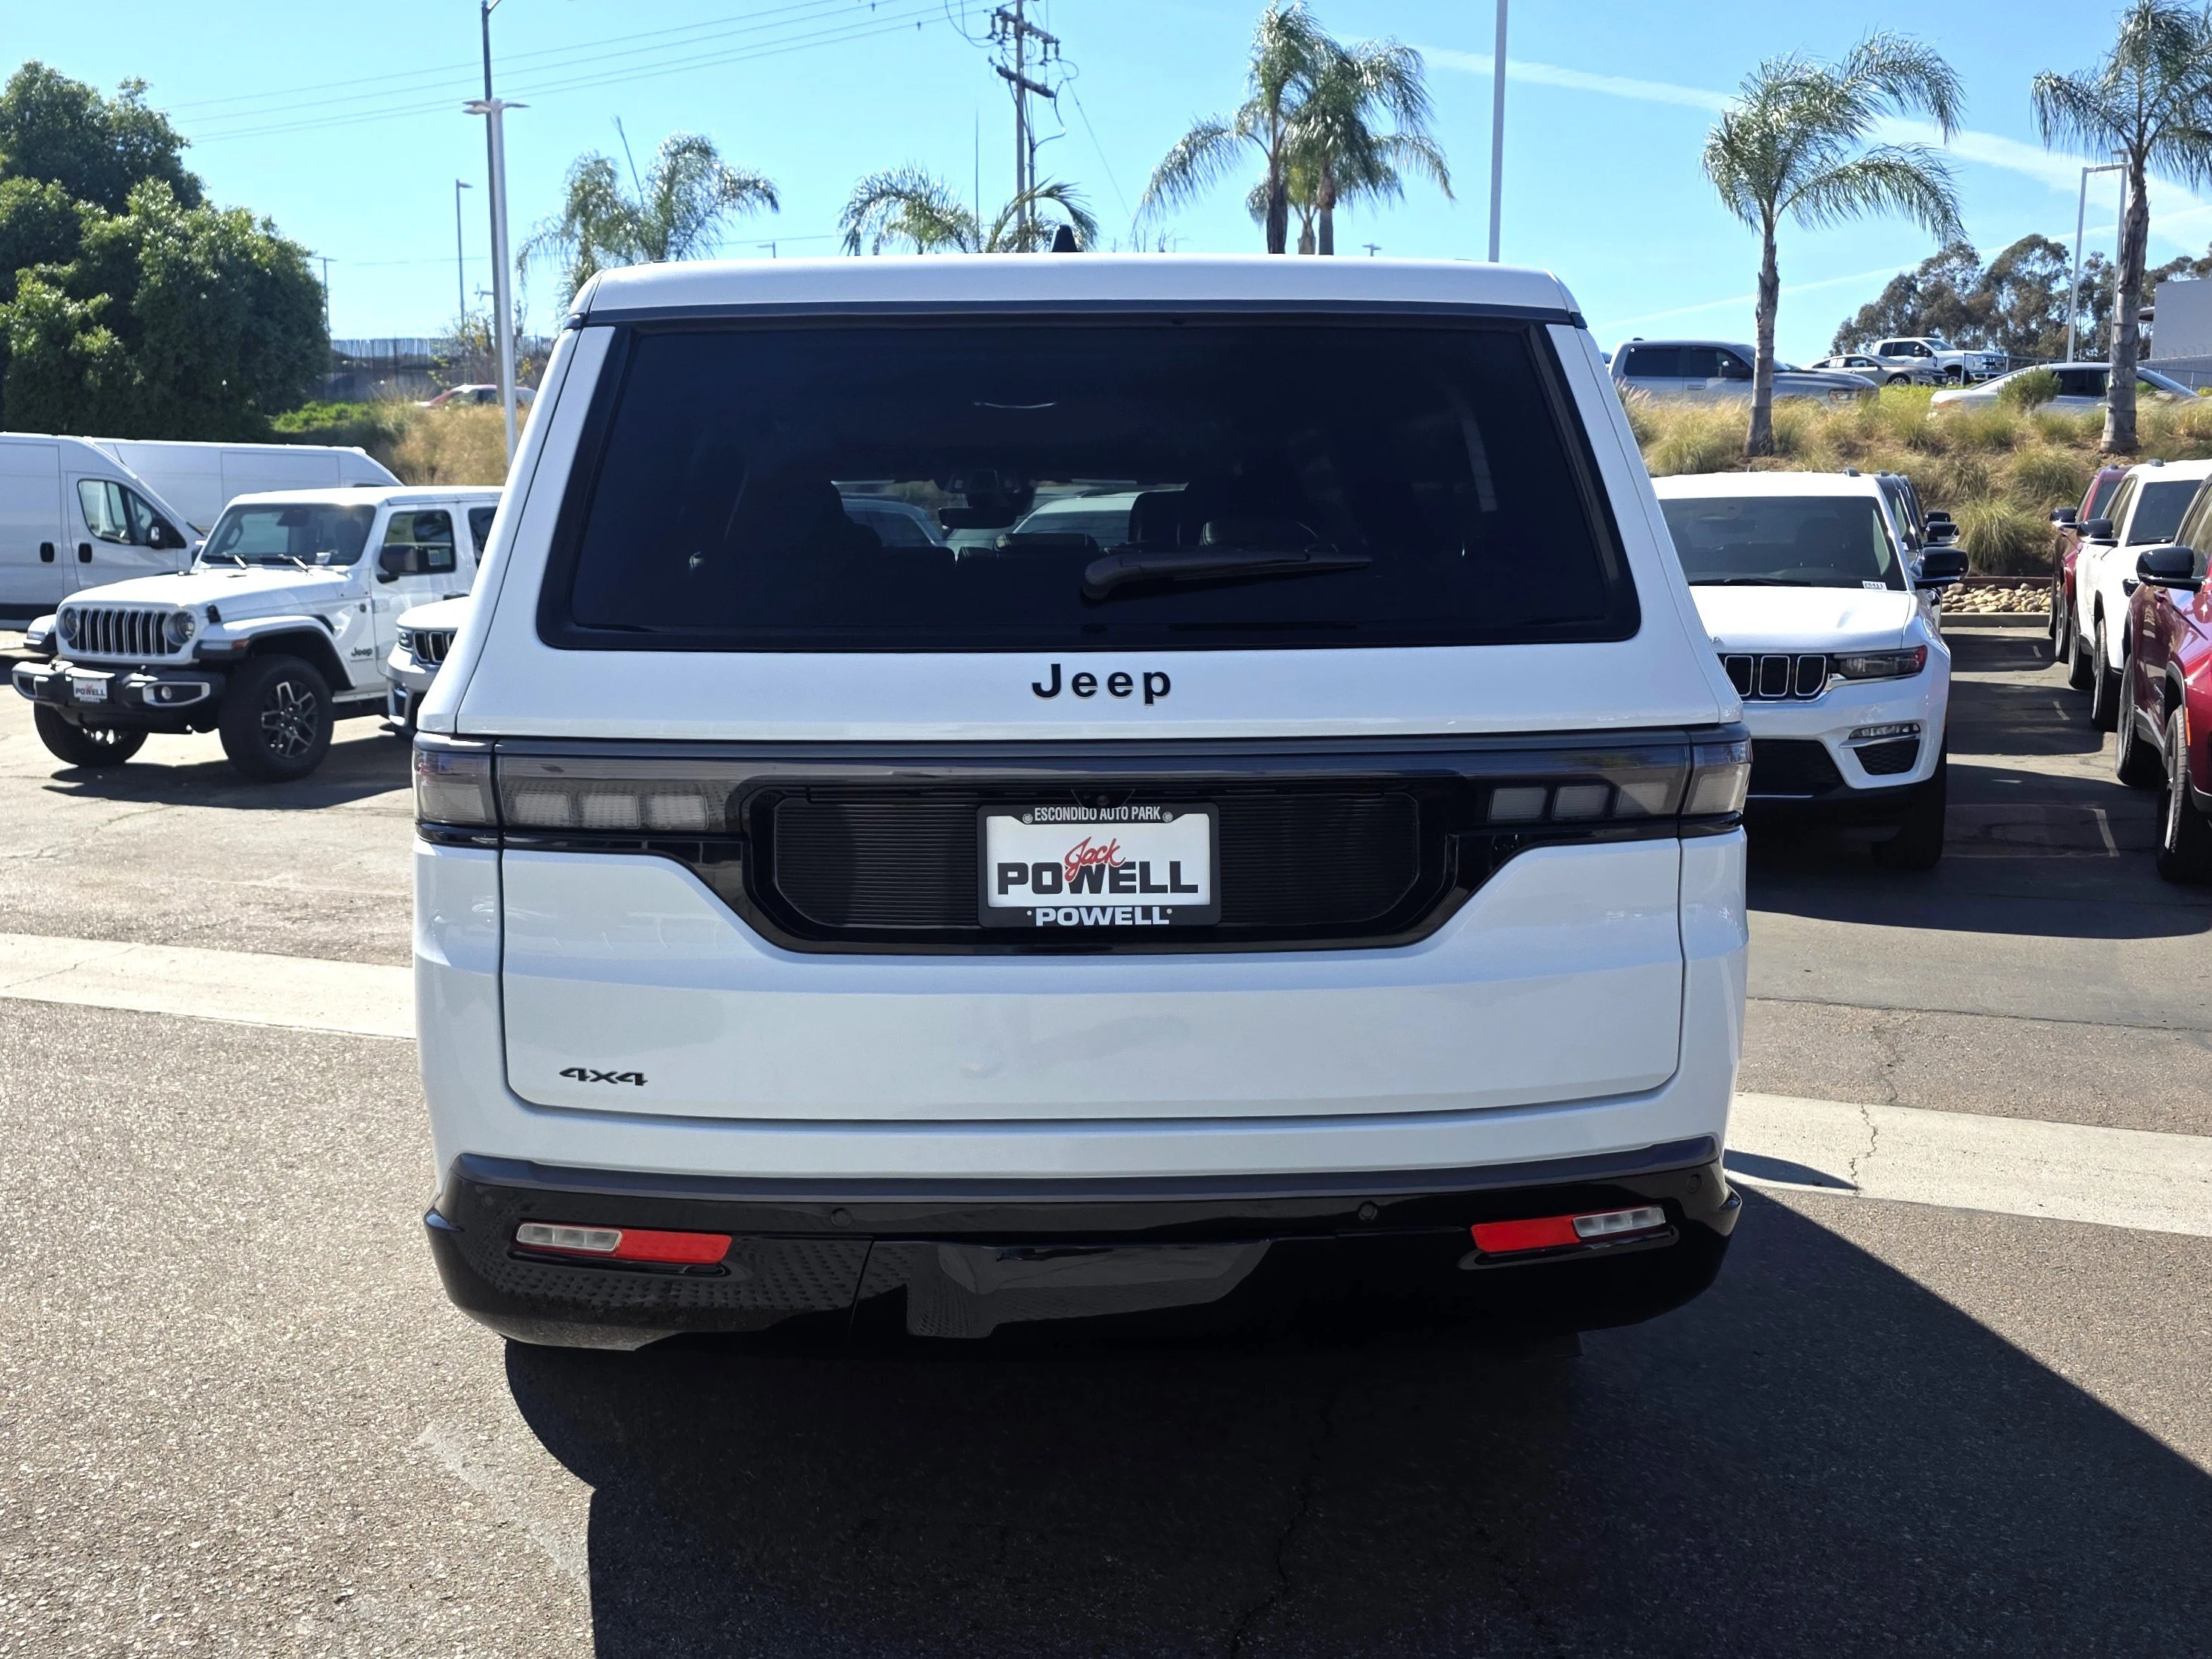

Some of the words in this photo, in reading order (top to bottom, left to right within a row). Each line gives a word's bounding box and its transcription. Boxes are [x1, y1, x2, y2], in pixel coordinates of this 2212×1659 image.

[351, 647, 373, 657] Jeep
[1031, 663, 1172, 706] Jeep
[1034, 807, 1097, 821] ESCONDIDO
[1099, 807, 1129, 820] AUTO
[1131, 806, 1161, 820] PARK
[1064, 836, 1126, 883] Jack
[997, 861, 1199, 895] POWELL
[1035, 906, 1170, 927] POWELL
